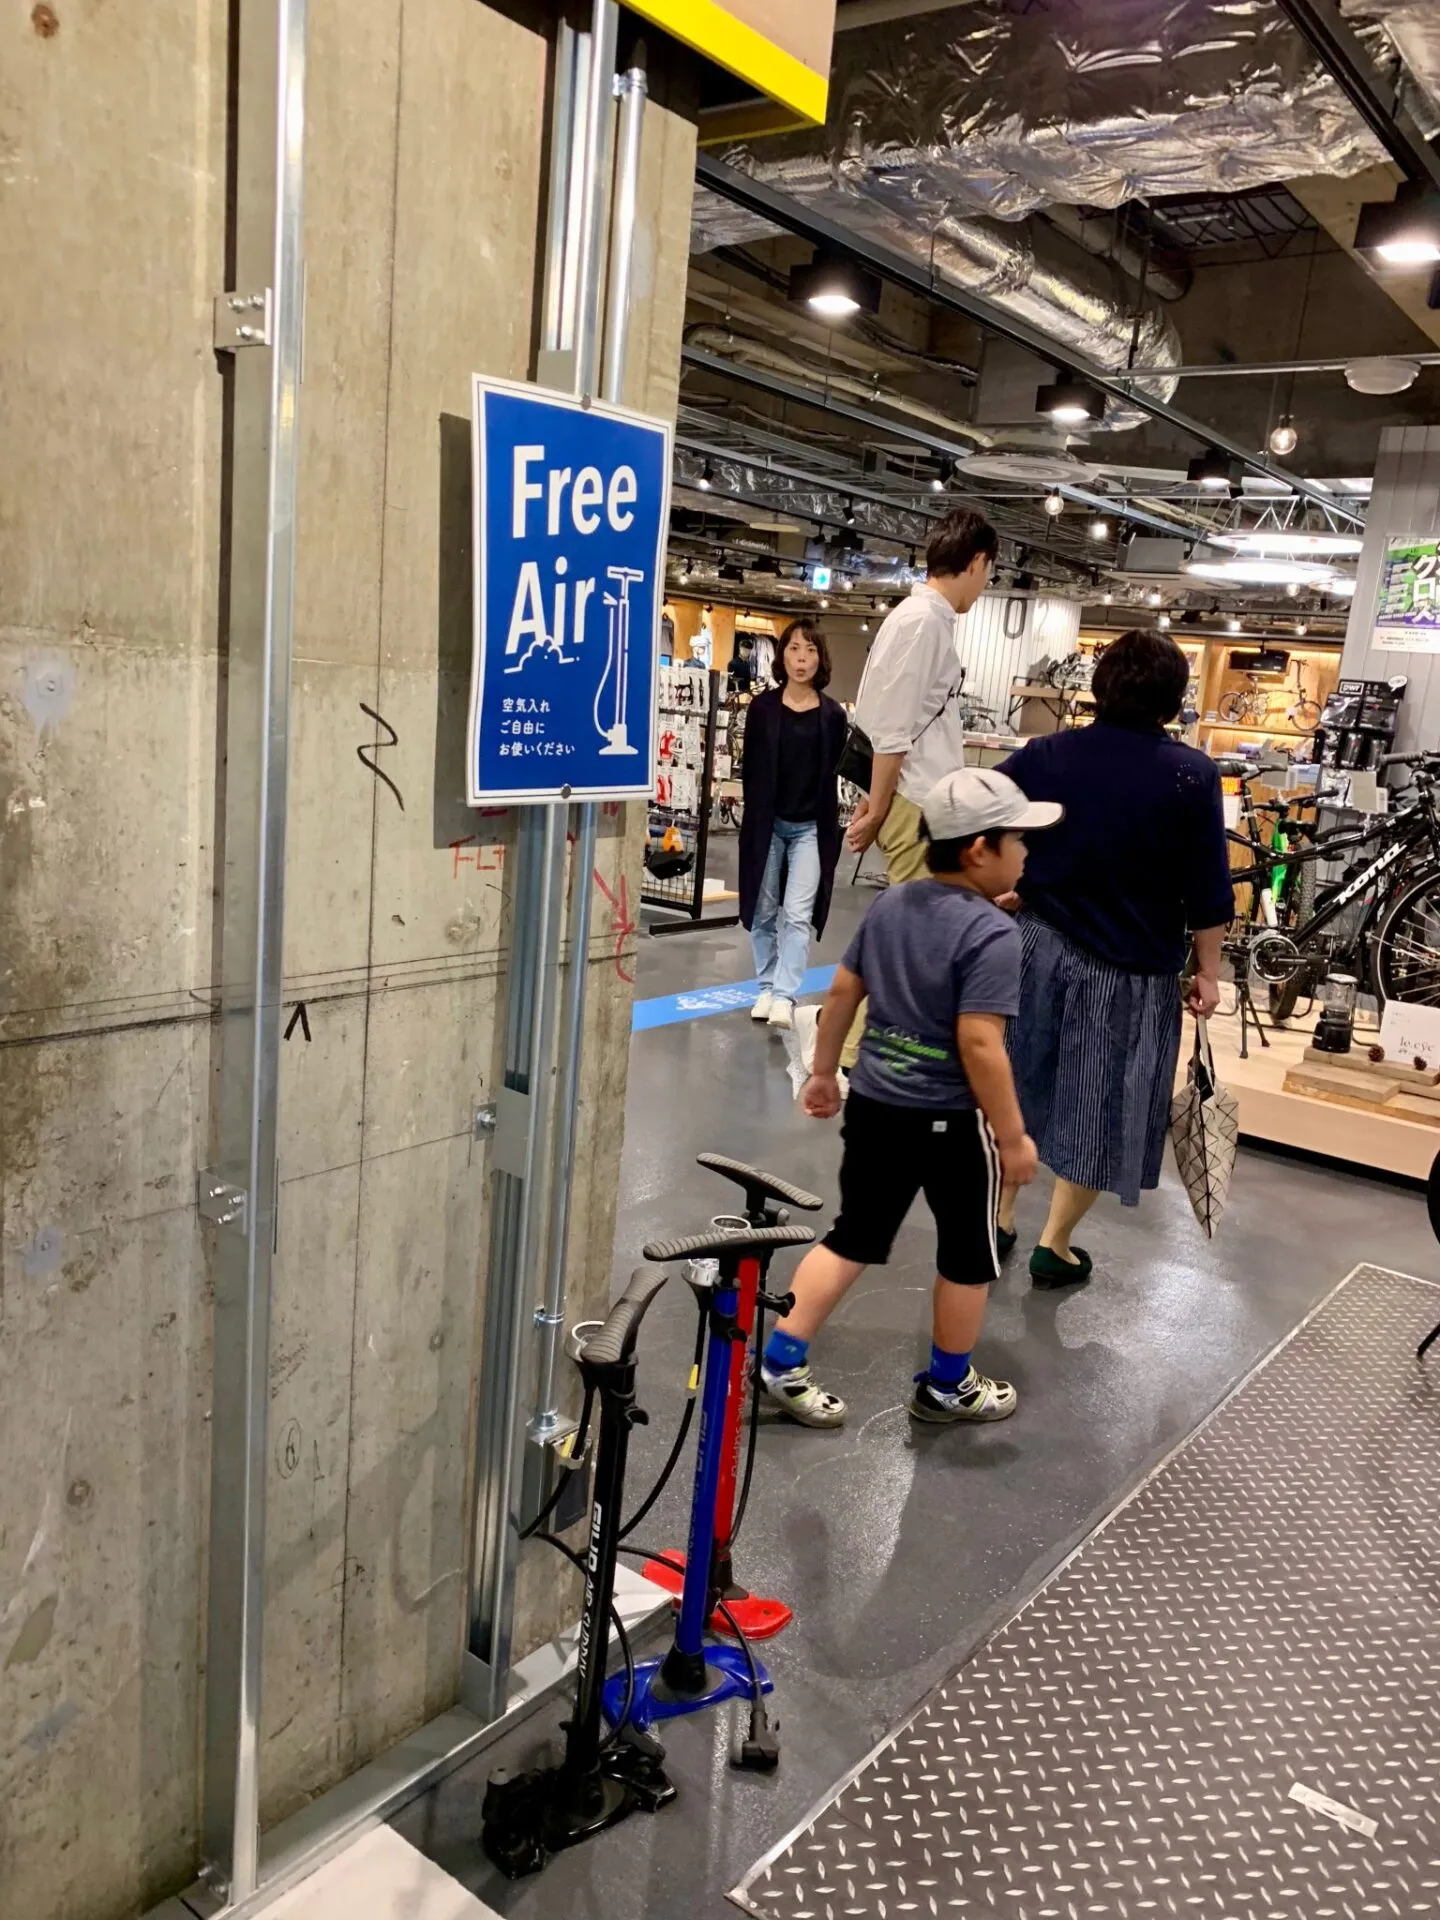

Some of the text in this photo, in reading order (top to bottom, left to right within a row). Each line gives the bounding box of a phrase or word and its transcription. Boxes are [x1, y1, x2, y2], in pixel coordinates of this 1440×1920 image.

[512, 444, 638, 539] Free
[504, 556, 595, 655] Air
[502, 697, 551, 713] 空気入れ
[500, 719, 545, 735] ご自由に
[499, 741, 576, 757] お使いください
